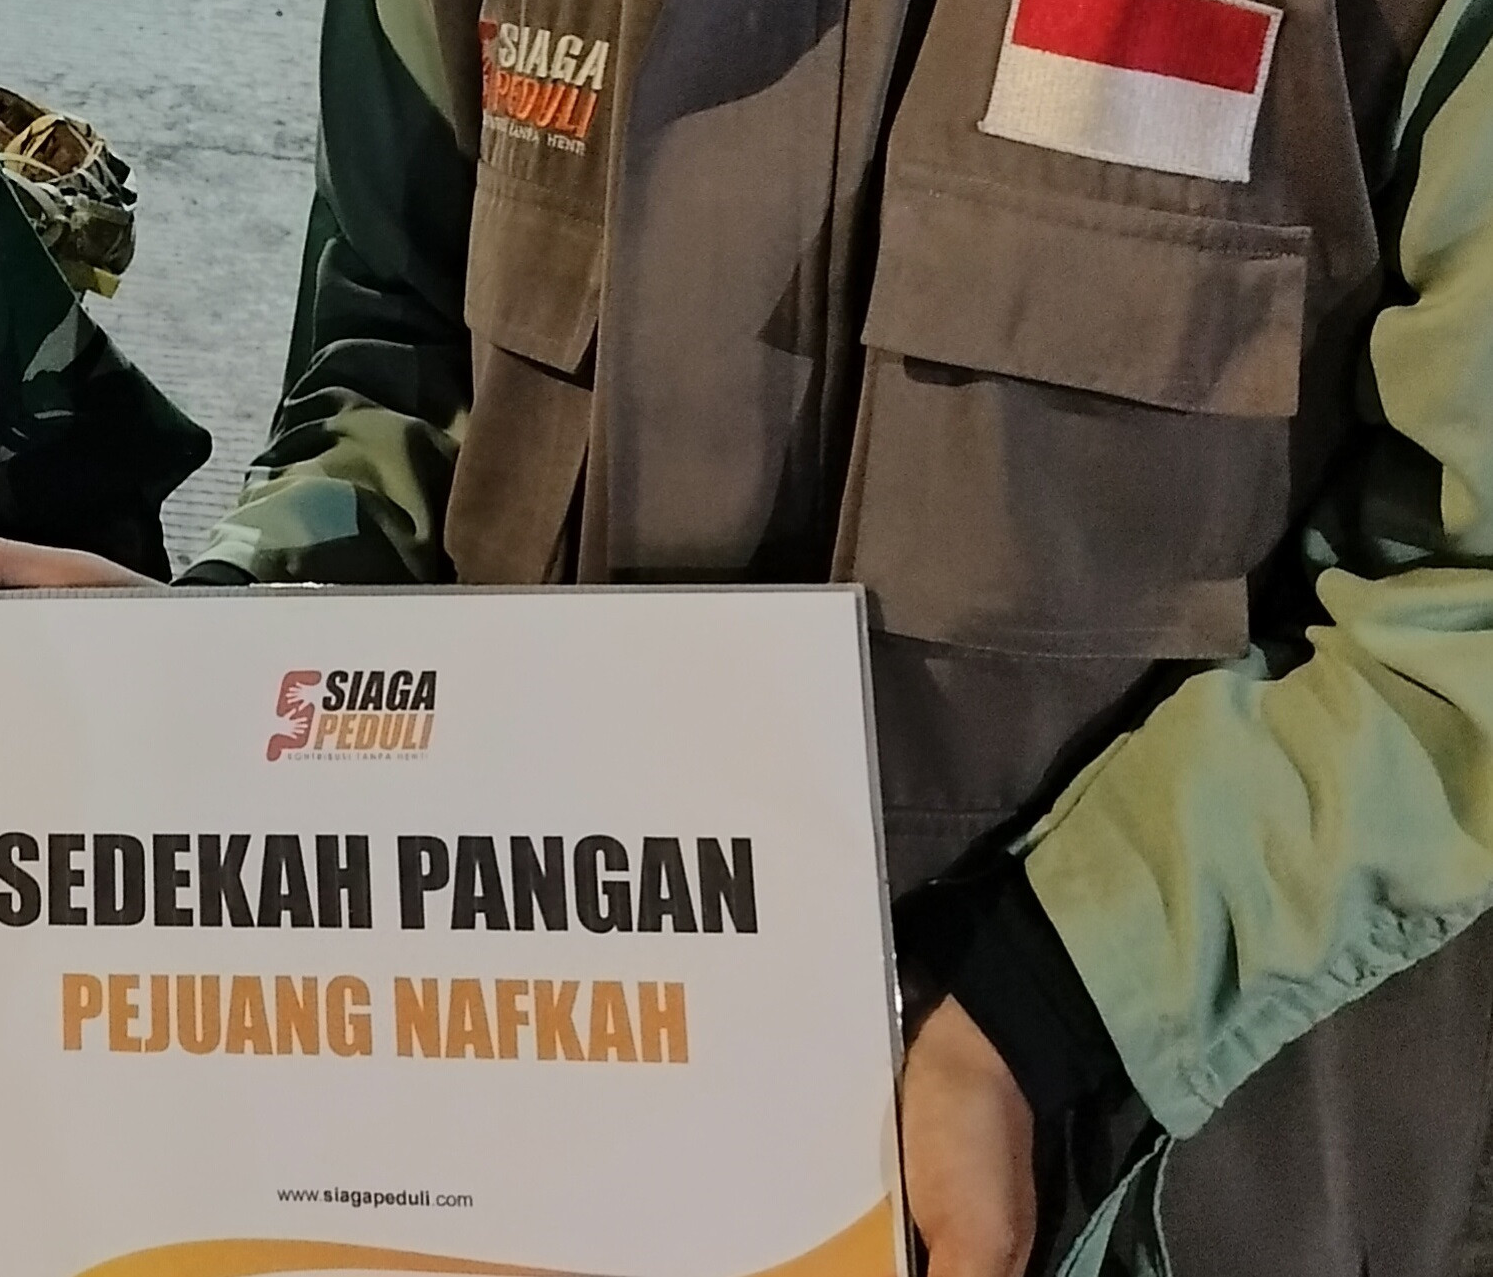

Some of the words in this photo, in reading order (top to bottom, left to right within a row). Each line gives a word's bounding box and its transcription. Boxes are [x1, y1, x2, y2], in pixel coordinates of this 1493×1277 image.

[497, 22, 610, 91] SIAGA
[492, 70, 598, 139] PEDULI
[322, 670, 437, 712] SIAGA
[313, 713, 435, 750] PEDULI
[396, 834, 759, 935] PANGAN
[61, 973, 373, 1058] PEJUANG
[393, 976, 689, 1065] NAFKAH
[277, 1187, 474, 1208] www.siagapeduli.com
